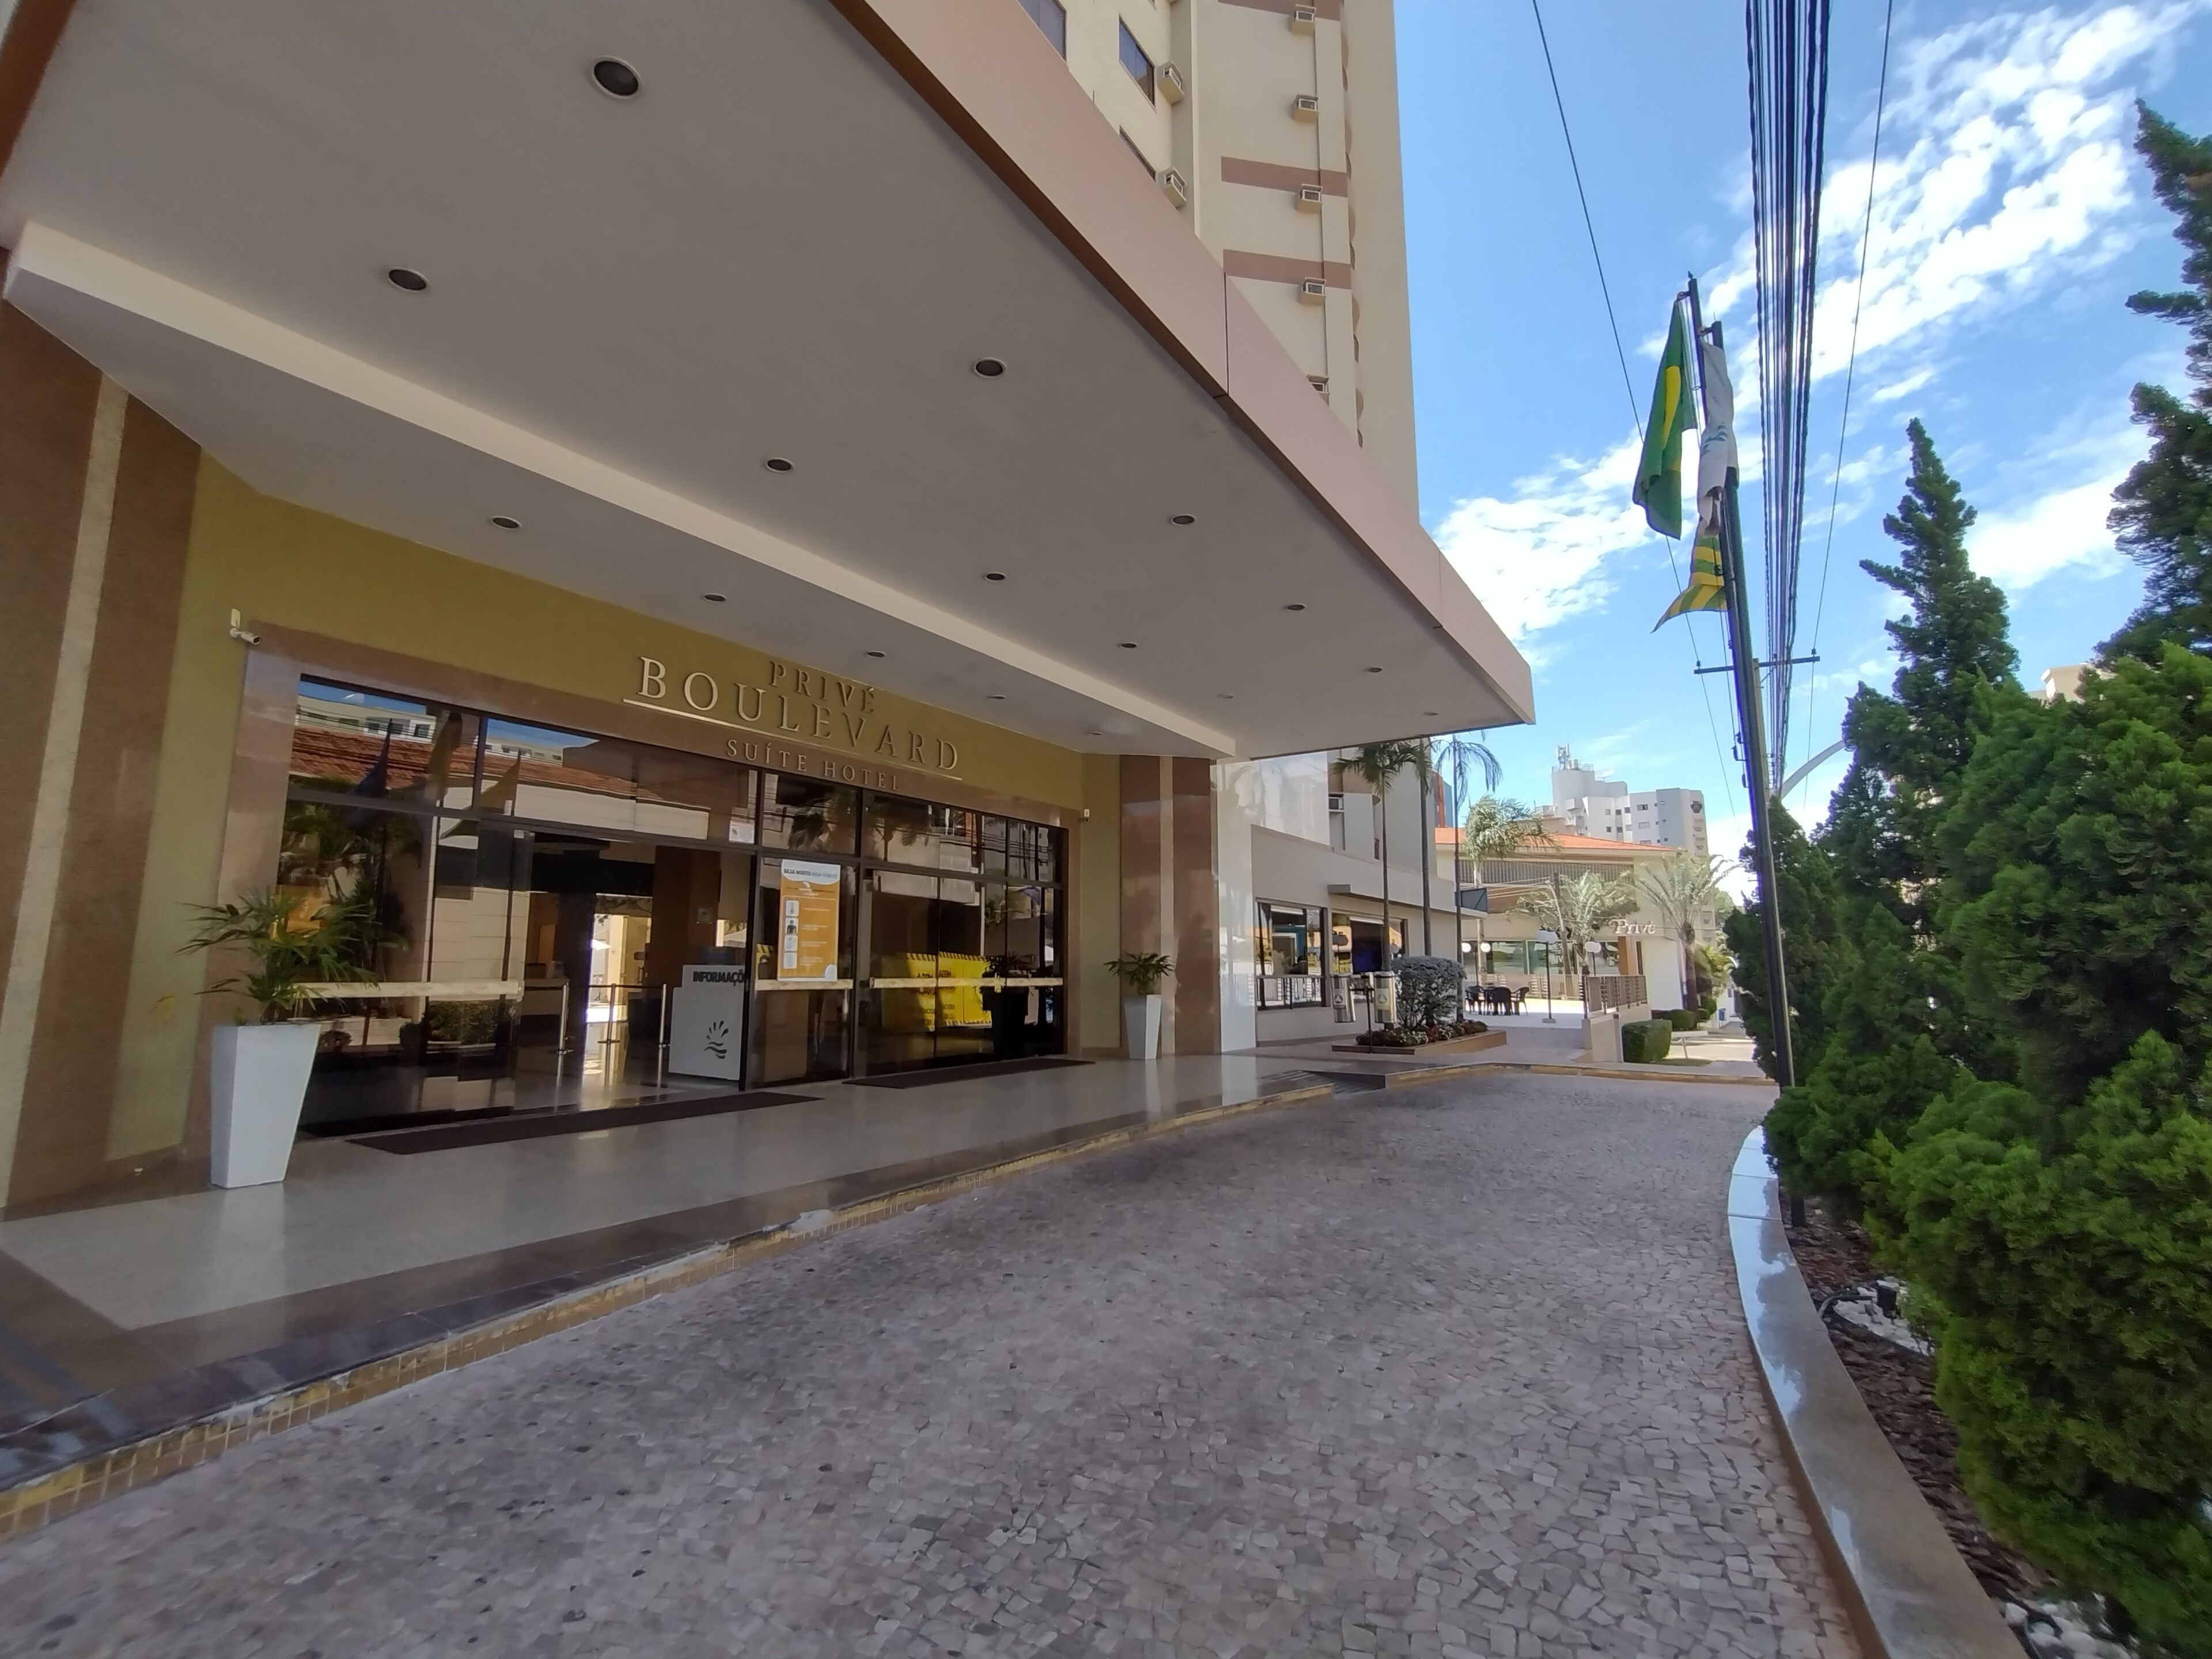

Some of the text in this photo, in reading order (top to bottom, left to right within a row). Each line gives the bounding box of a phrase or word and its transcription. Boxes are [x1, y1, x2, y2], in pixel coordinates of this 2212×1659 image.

[637, 656, 959, 770] BOULEVARD
[770, 661, 874, 714] PRIVÉ
[727, 739, 900, 791] SUÍTE HOTEL
